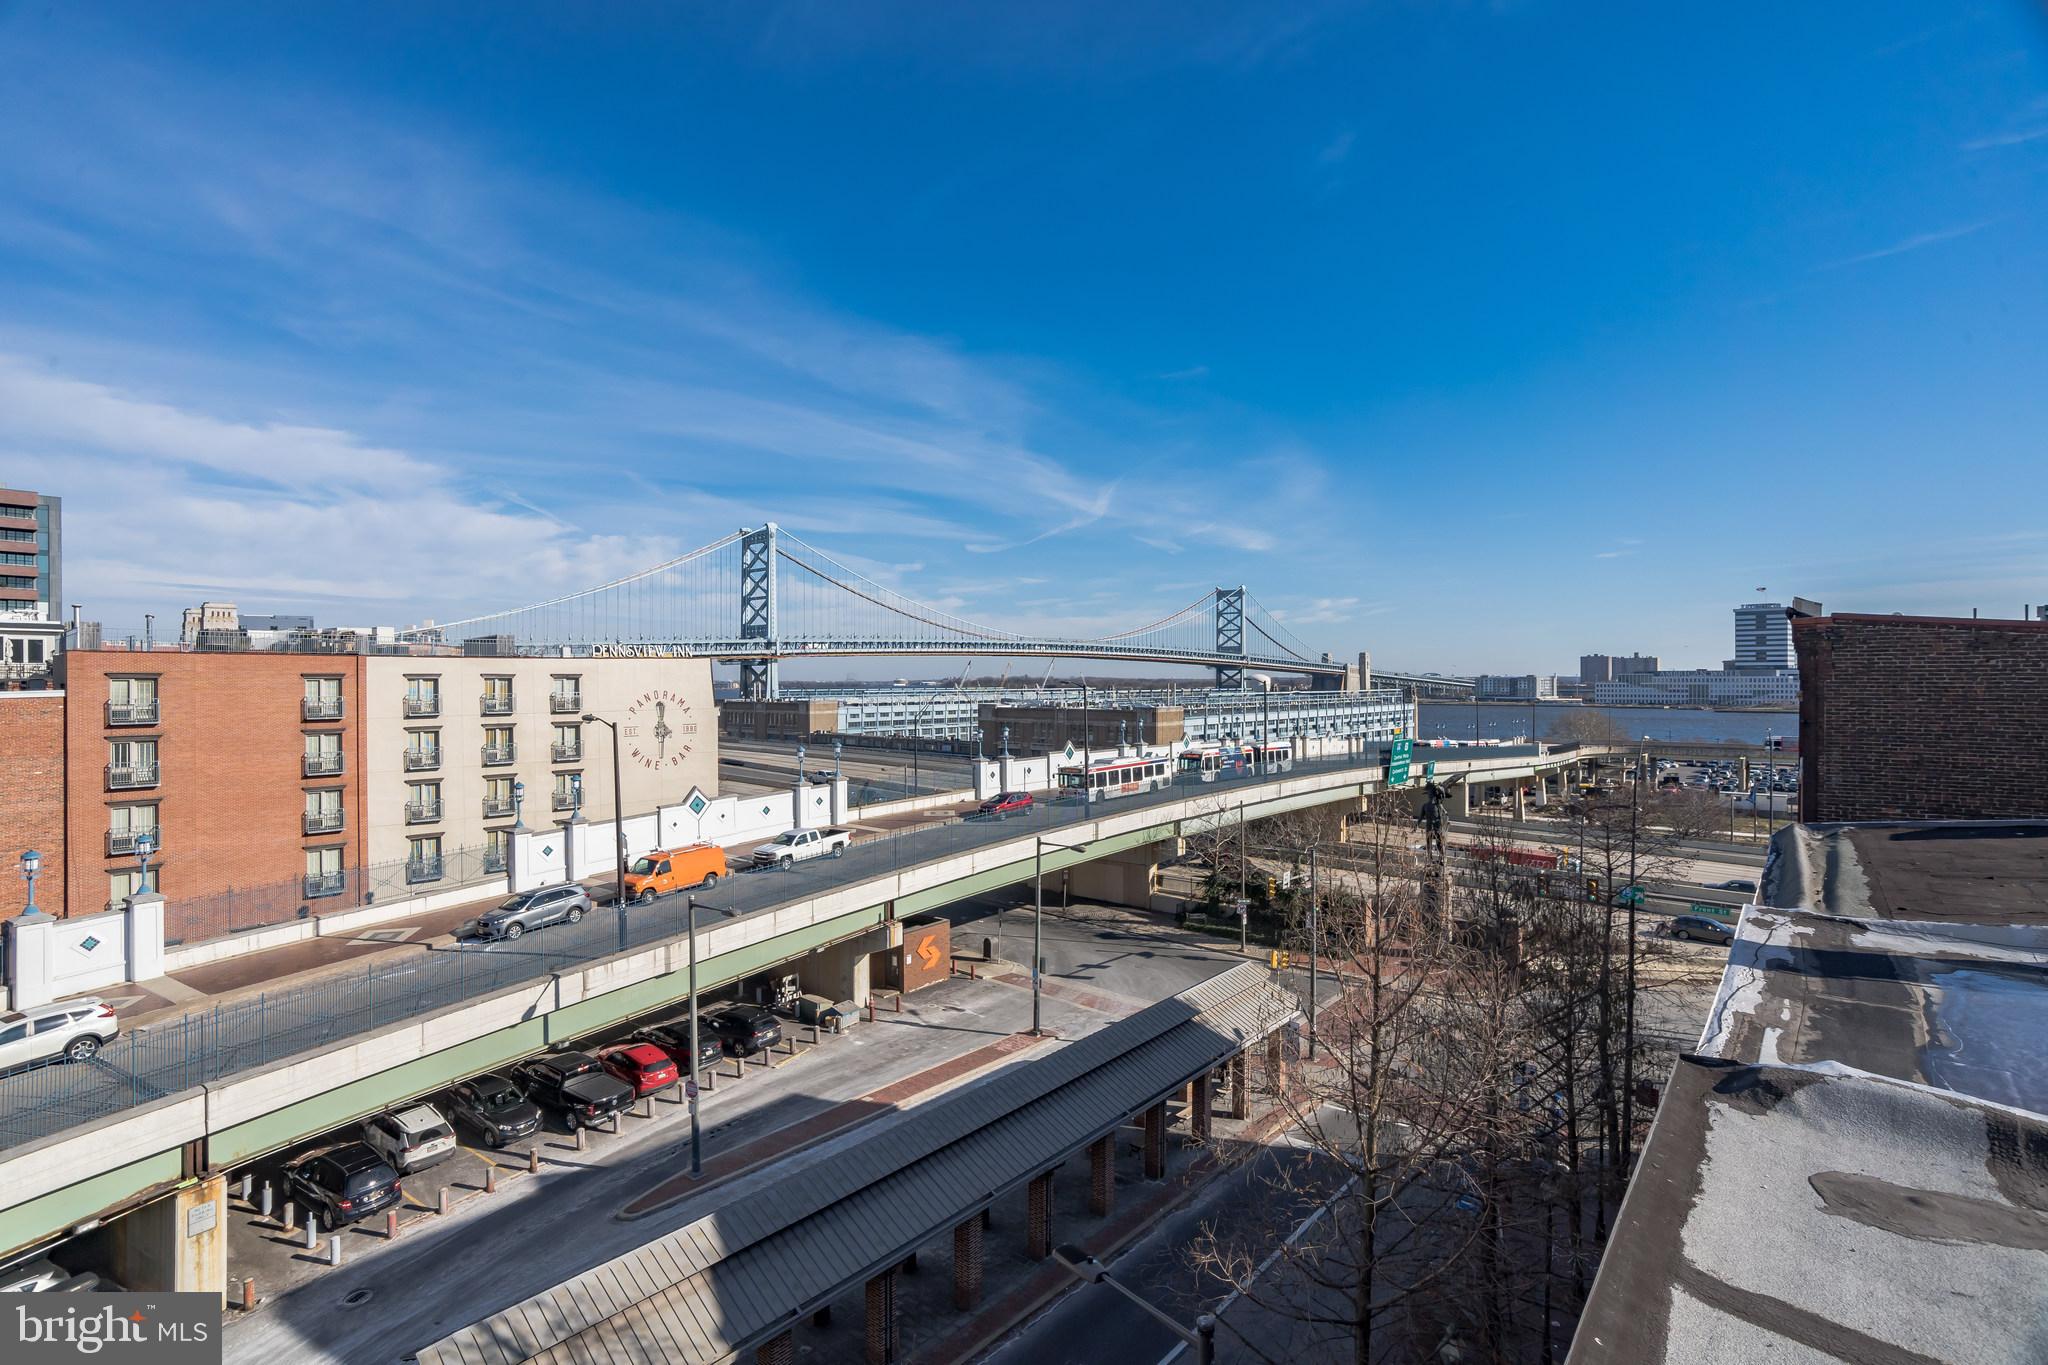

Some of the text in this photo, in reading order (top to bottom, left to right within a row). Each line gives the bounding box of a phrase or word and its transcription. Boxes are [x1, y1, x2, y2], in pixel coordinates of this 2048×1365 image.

[592, 644, 693, 657] PENNSVIEW INN
[629, 690, 691, 715] PANORAMA
[631, 744, 692, 770] WINE BAR
